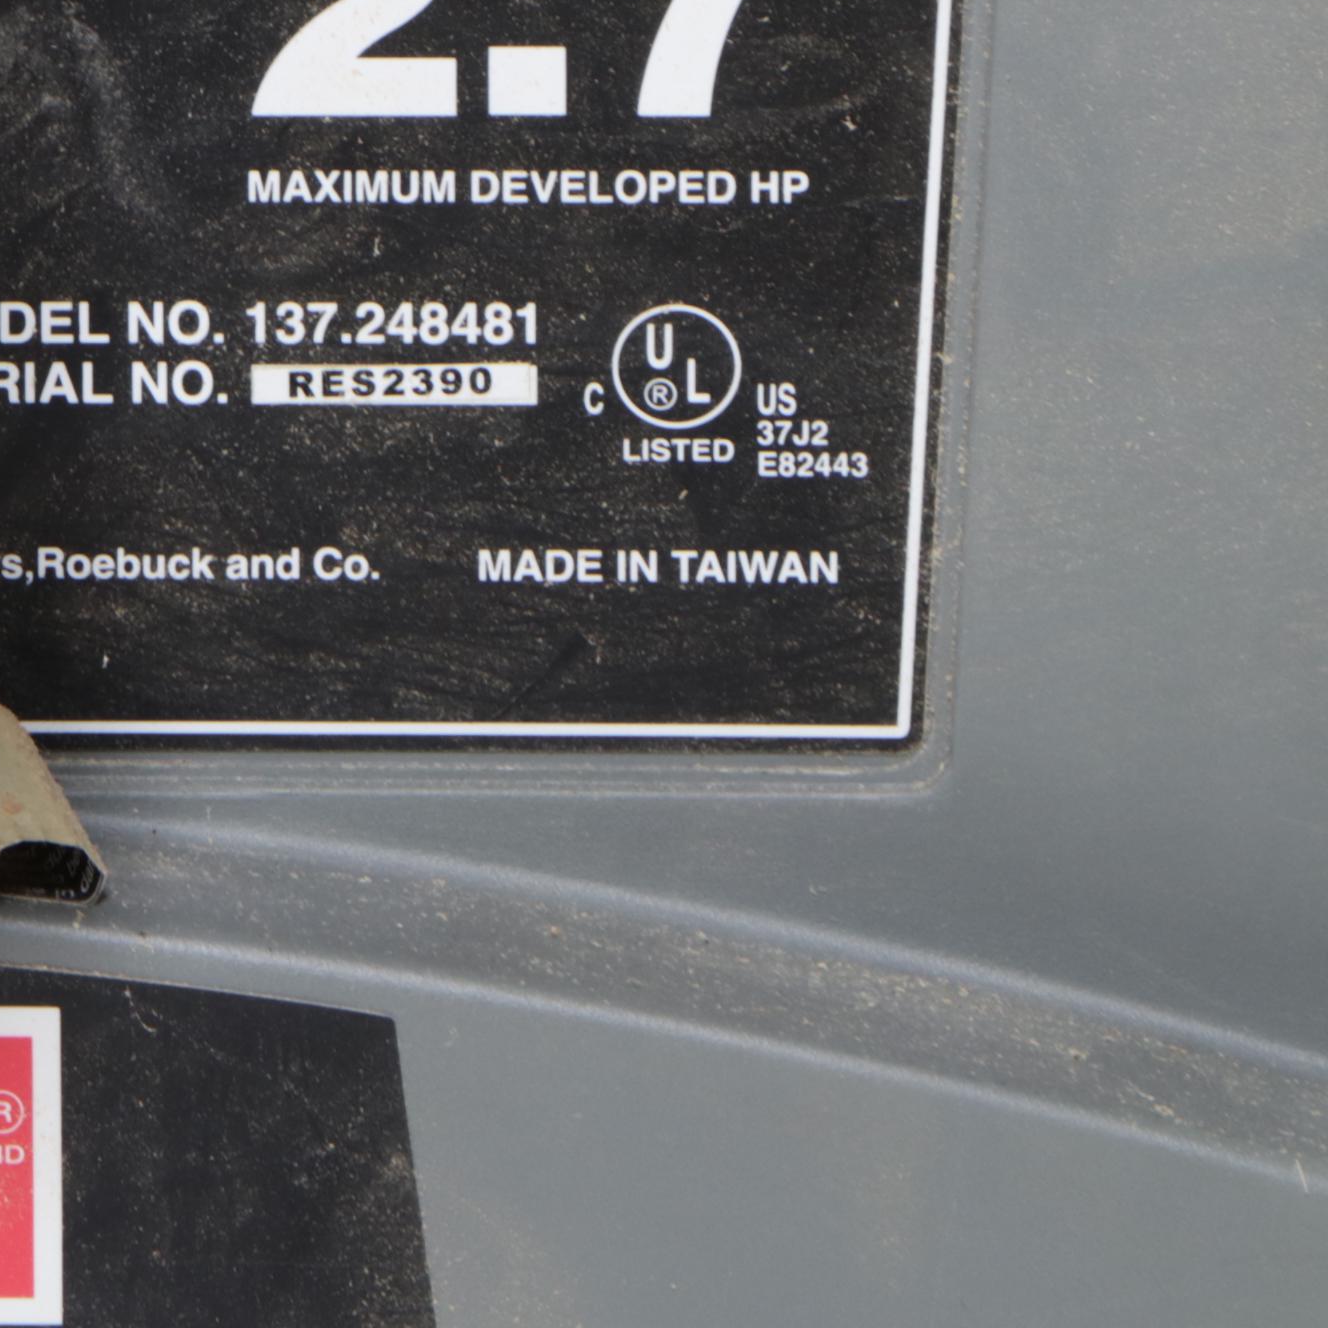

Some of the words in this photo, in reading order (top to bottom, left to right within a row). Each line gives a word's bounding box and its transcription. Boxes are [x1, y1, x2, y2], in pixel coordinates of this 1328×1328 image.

[248, 170, 455, 203] MAXIMUM
[471, 170, 736, 204] DEVELOPED
[751, 171, 809, 203] HP
[128, 300, 224, 345] NO.
[246, 302, 536, 347] 137.248481
[132, 360, 227, 404] NO.
[287, 367, 493, 398] RES2390
[758, 383, 796, 415] US
[757, 420, 828, 446] 37J2
[623, 438, 734, 463] LISTED
[758, 452, 868, 477] E82443
[226, 548, 300, 580] and
[314, 547, 379, 580] Co.
[478, 550, 602, 584] MADE
[618, 550, 657, 582] IN
[671, 550, 838, 583] TAIWAN
